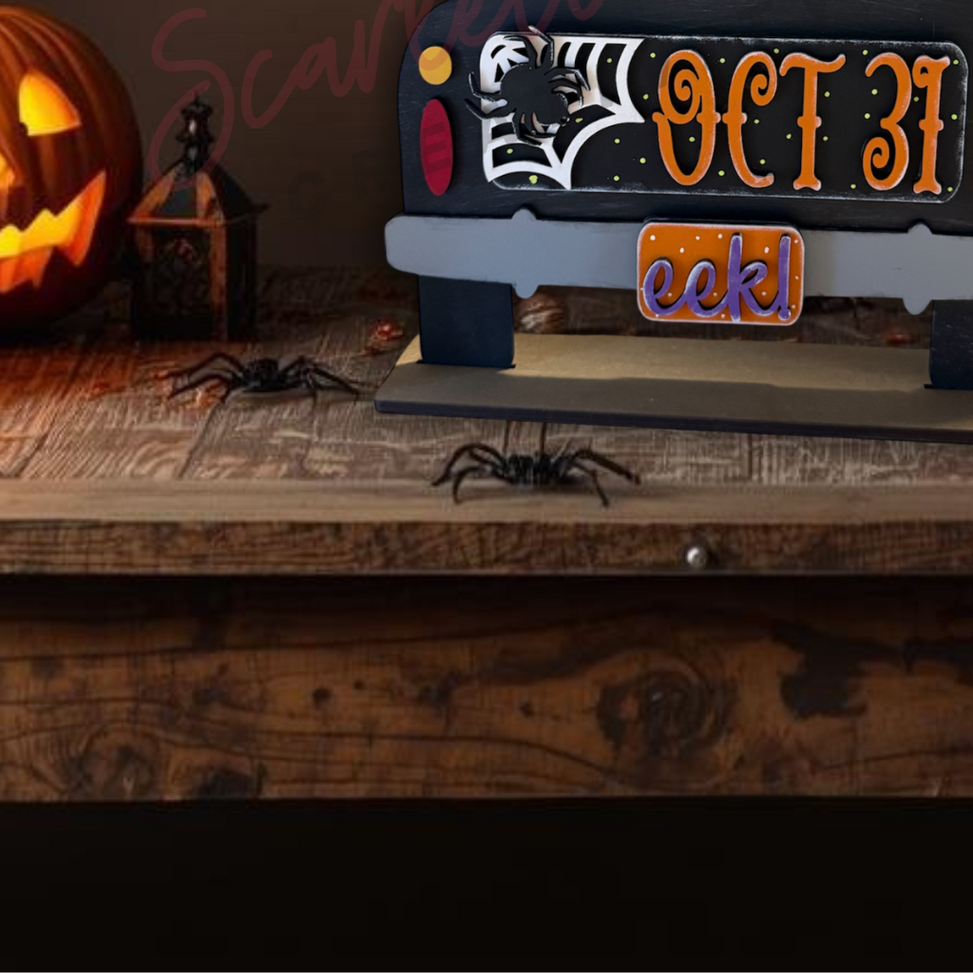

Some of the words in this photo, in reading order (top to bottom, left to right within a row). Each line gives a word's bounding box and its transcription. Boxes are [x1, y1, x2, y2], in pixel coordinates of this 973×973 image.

[652, 48, 846, 191] OCT
[862, 52, 950, 195] 31
[643, 233, 791, 323] eek!
